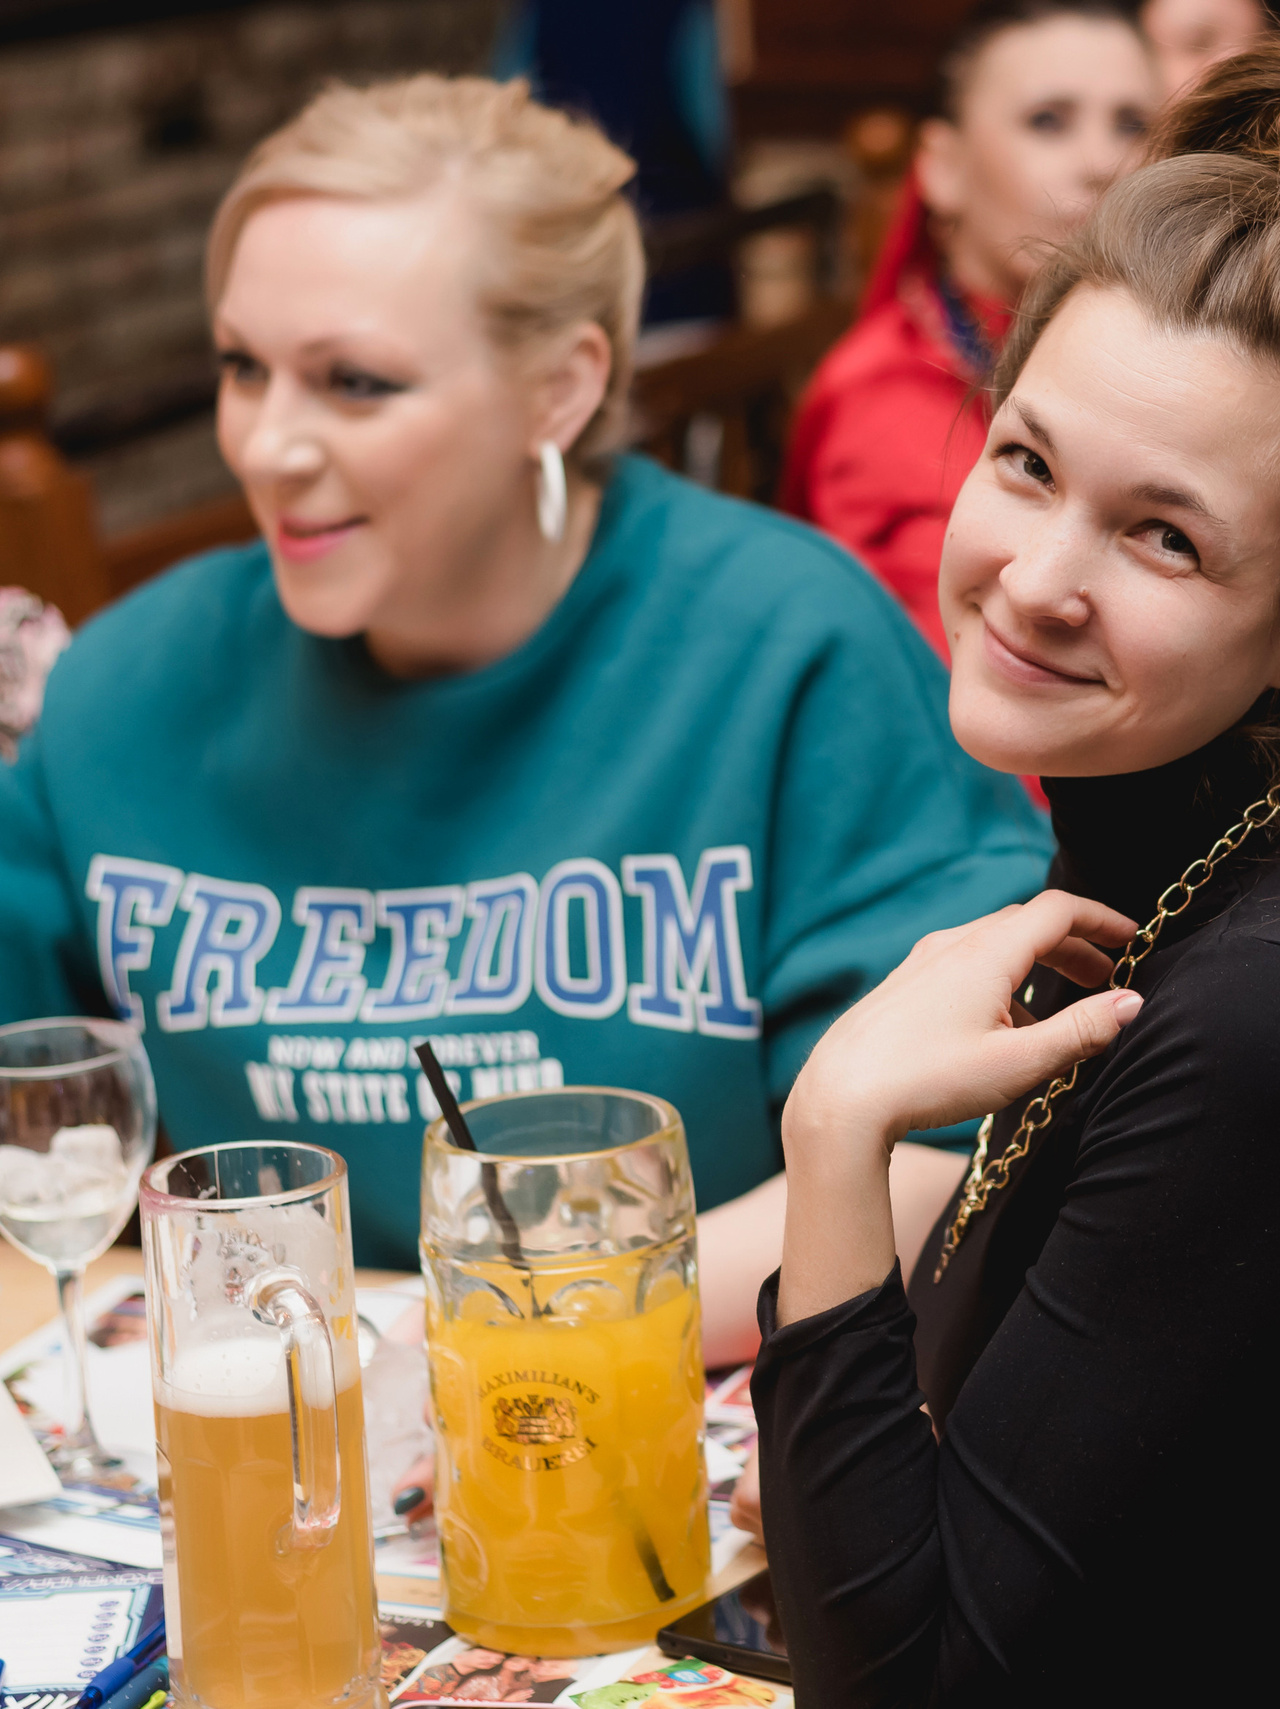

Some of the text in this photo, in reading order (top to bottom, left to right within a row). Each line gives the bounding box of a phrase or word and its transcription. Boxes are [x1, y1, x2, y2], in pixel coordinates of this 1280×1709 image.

[86, 846, 761, 1039] FREEDOM
[268, 1034, 345, 1069] NOW
[345, 1037, 407, 1069] AND
[302, 1070, 411, 1123] STATE
